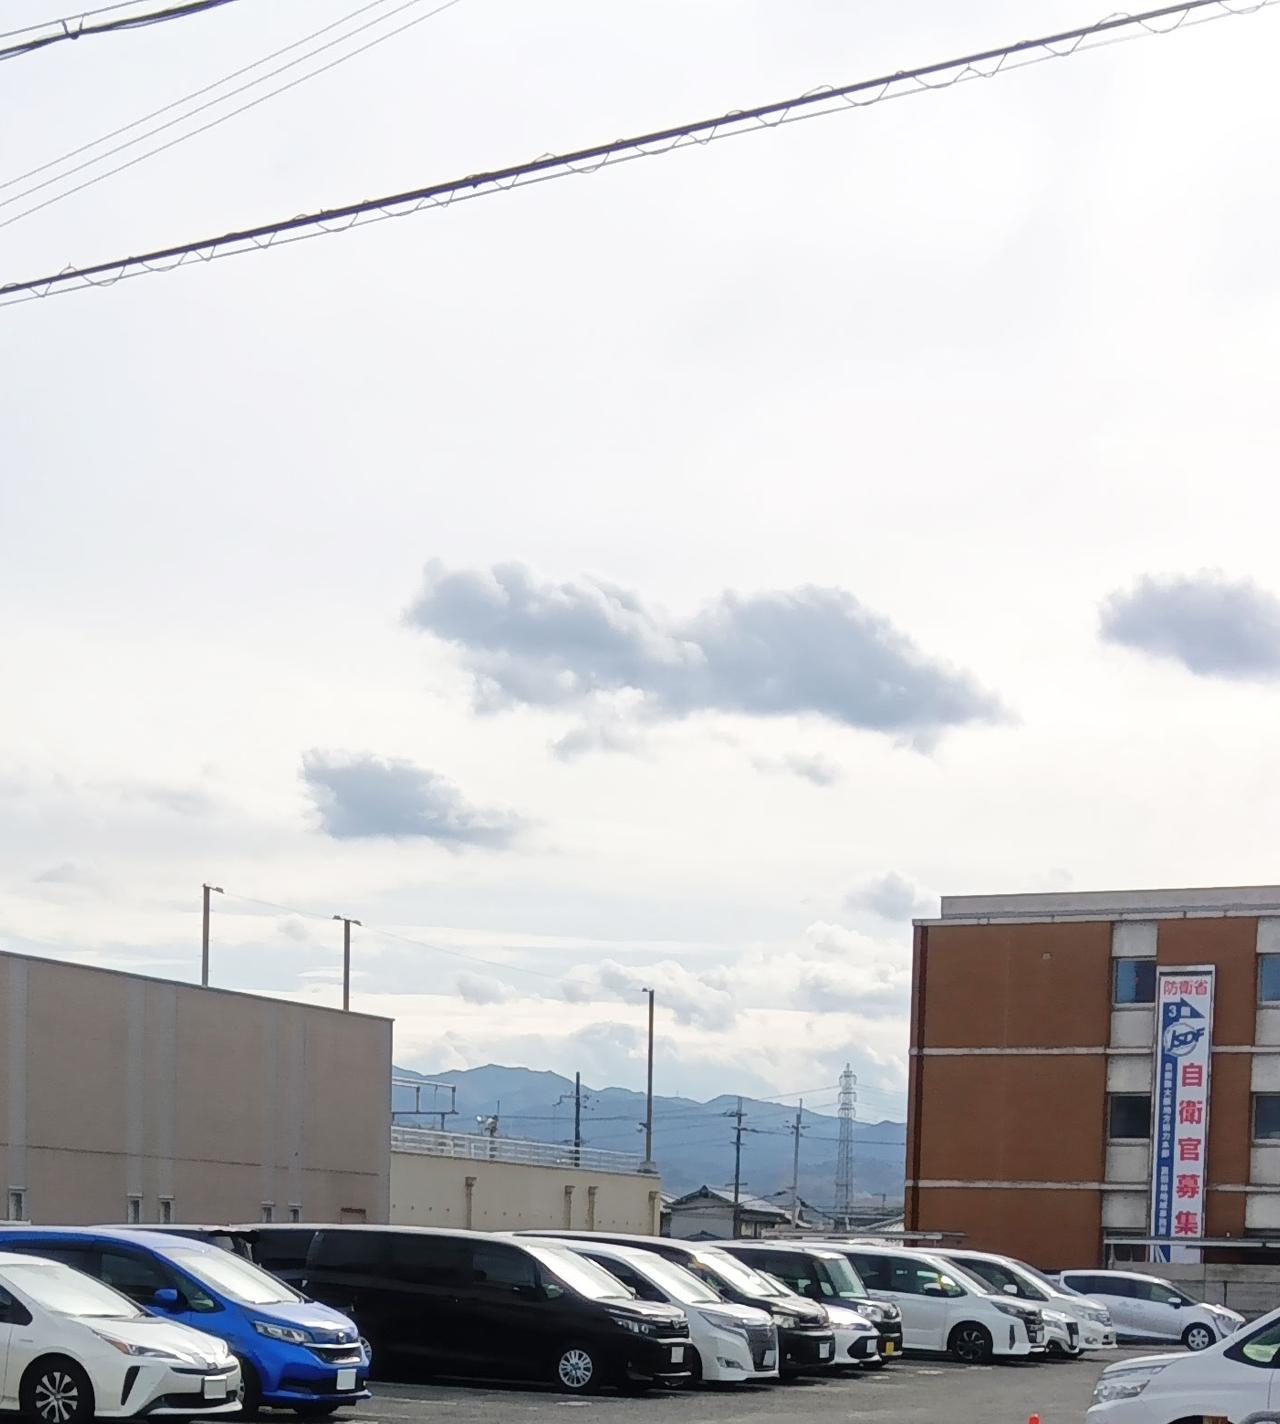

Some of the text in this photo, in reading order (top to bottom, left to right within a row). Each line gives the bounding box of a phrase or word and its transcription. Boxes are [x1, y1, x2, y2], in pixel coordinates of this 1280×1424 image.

[1163, 980, 1209, 996] 防衛省
[1174, 1062, 1203, 1236] 自衛官募集
